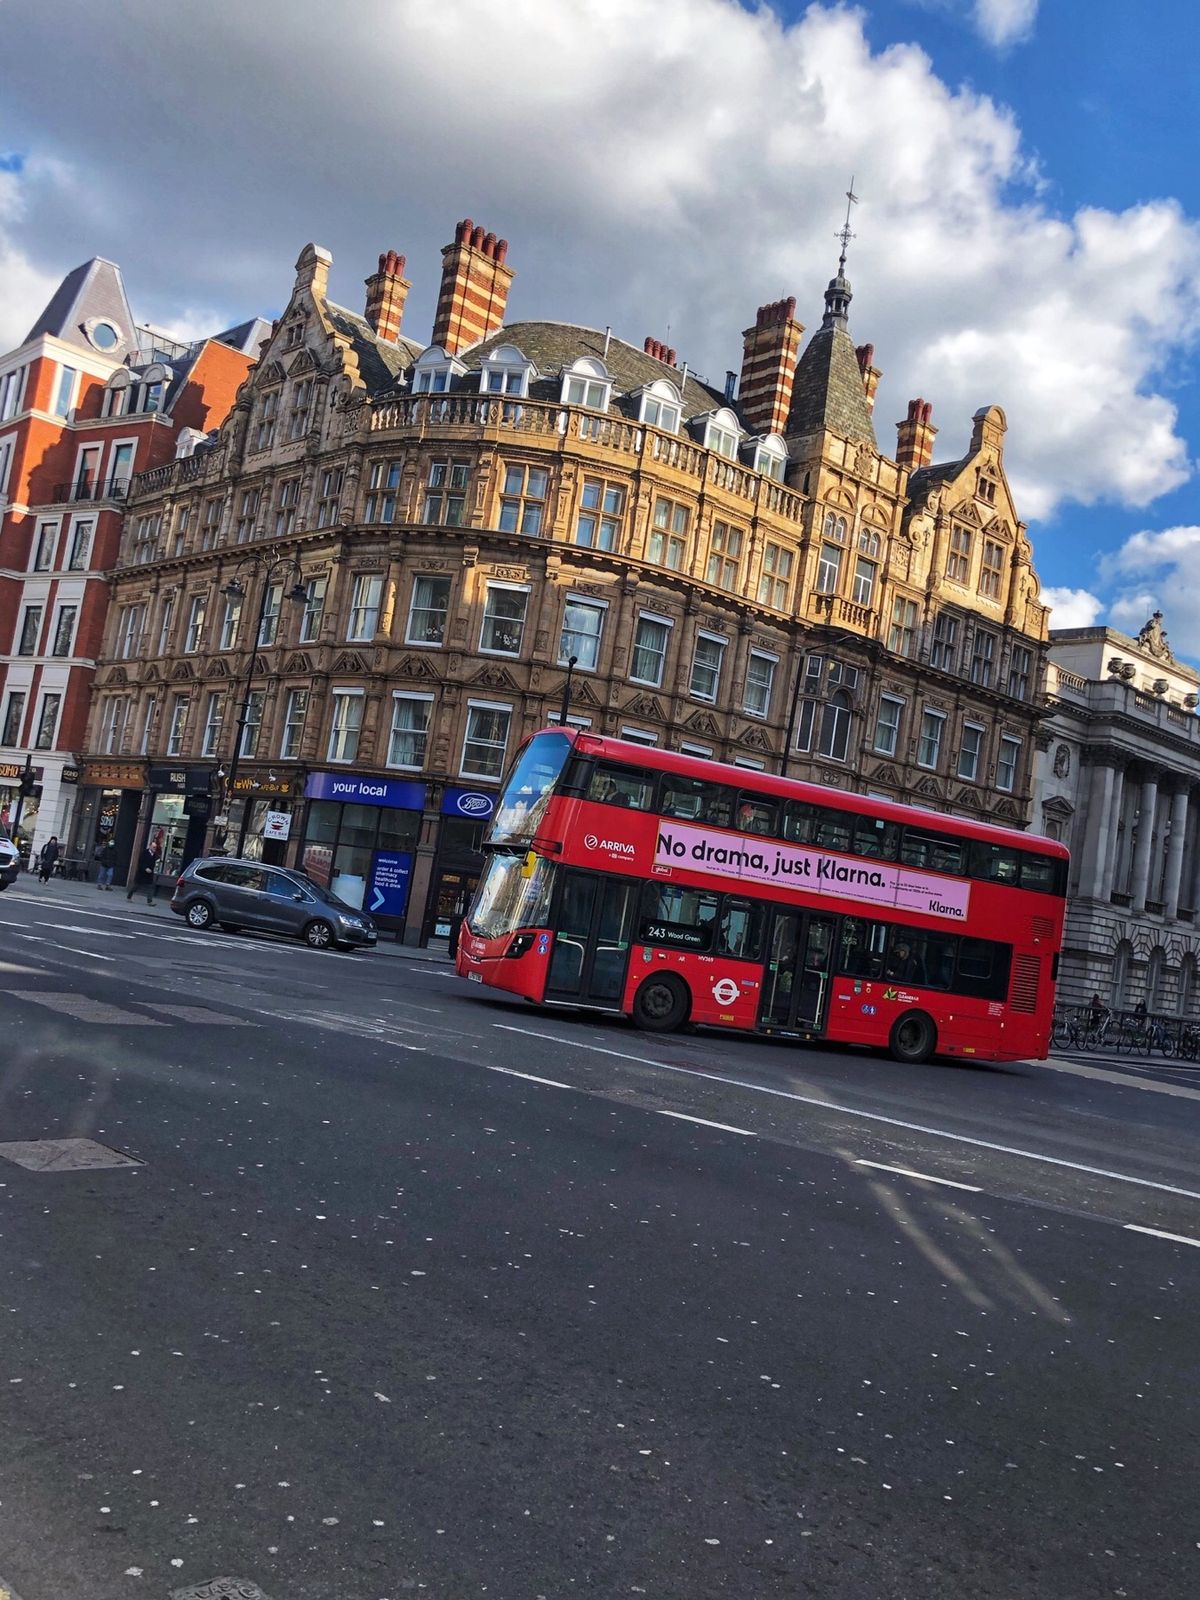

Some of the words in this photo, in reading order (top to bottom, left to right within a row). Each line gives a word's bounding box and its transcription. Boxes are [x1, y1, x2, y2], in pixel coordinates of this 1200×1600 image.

[0, 764, 18, 777] SOHO
[170, 772, 186, 782] RUSH
[332, 782, 357, 793] your
[358, 782, 387, 797] local
[462, 797, 488, 810] Boots
[268, 814, 289, 825] CROWN
[599, 840, 636, 855] ARRIVA
[656, 833, 686, 858] No
[691, 840, 769, 873] drama,
[772, 851, 811, 877] just
[816, 858, 886, 888] Klarna.
[928, 899, 964, 917] Klarna.
[648, 926, 666, 938] 243
[667, 931, 684, 940] Wood
[684, 934, 701, 943] Green
